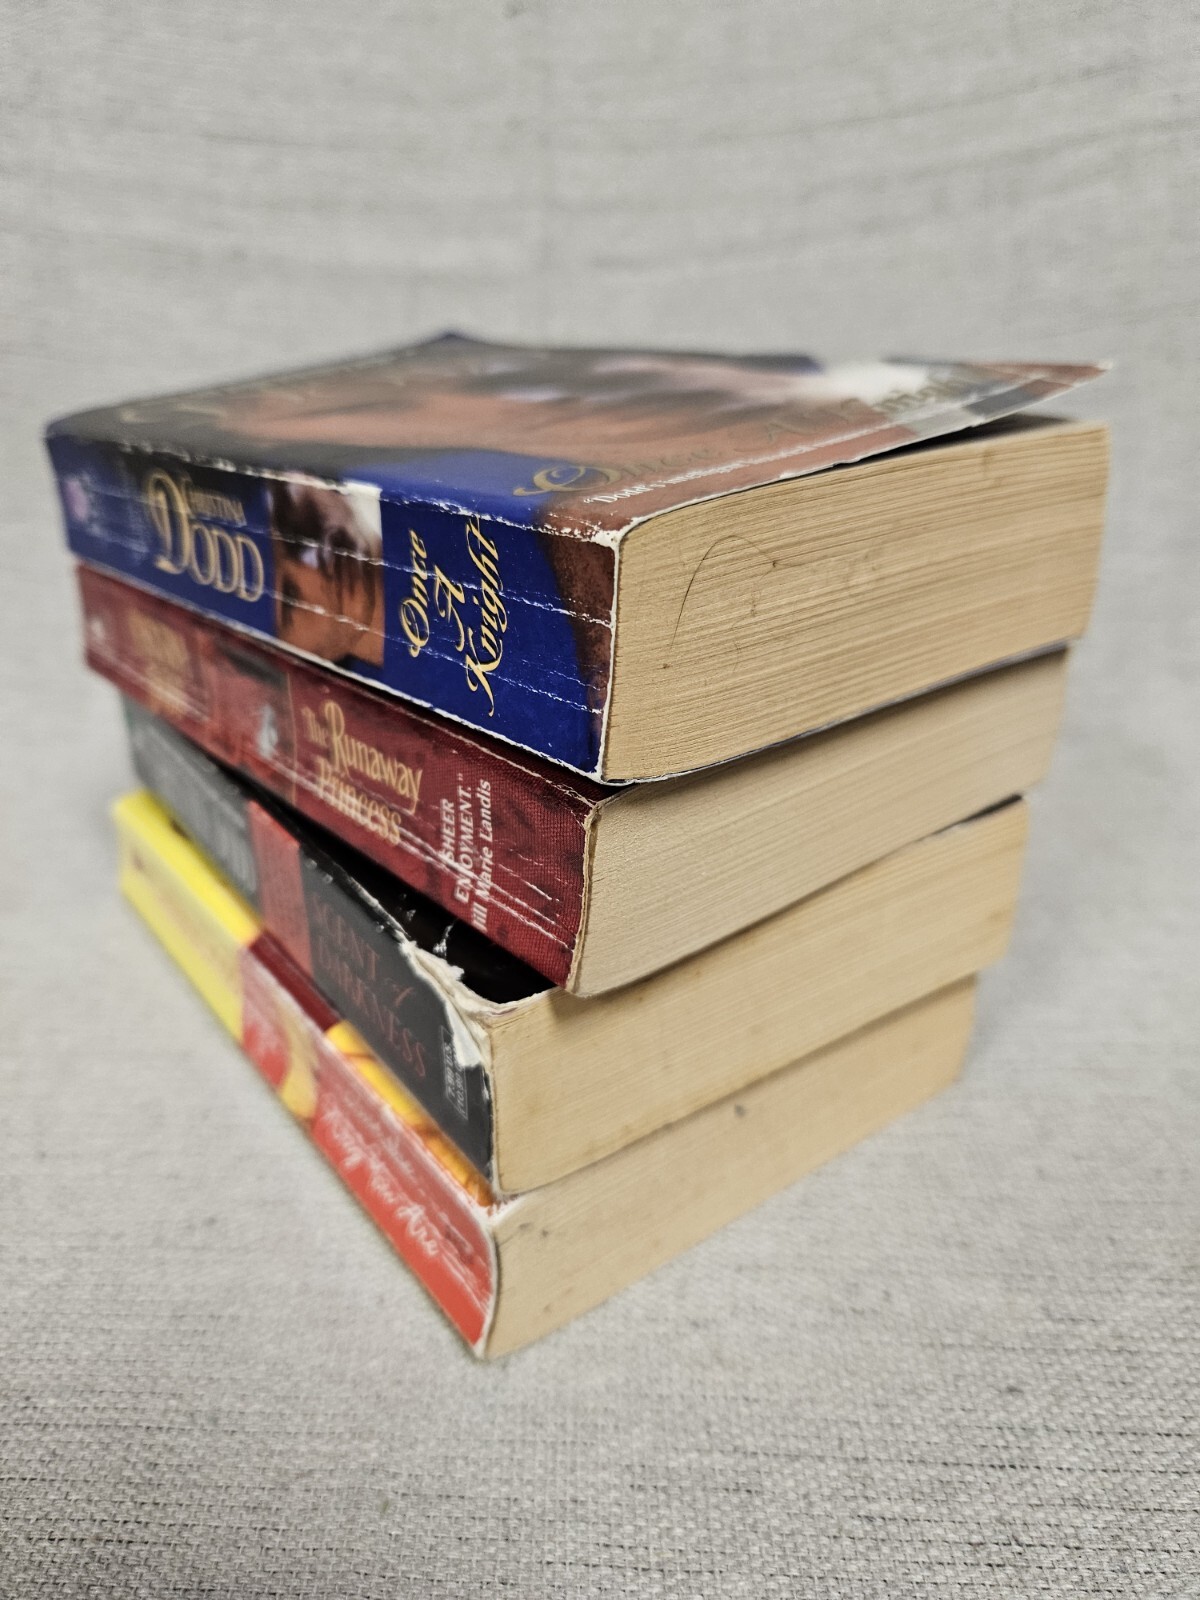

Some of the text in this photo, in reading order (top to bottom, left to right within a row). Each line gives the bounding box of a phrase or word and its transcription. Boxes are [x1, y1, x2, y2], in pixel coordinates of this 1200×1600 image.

[401, 528, 429, 658] Once
[434, 564, 465, 652] A
[465, 514, 507, 717] Knight
[323, 699, 423, 815] Runaway
[476, 779, 493, 843] Landis
[475, 846, 494, 900] Marie
[396, 1203, 440, 1258] Are
